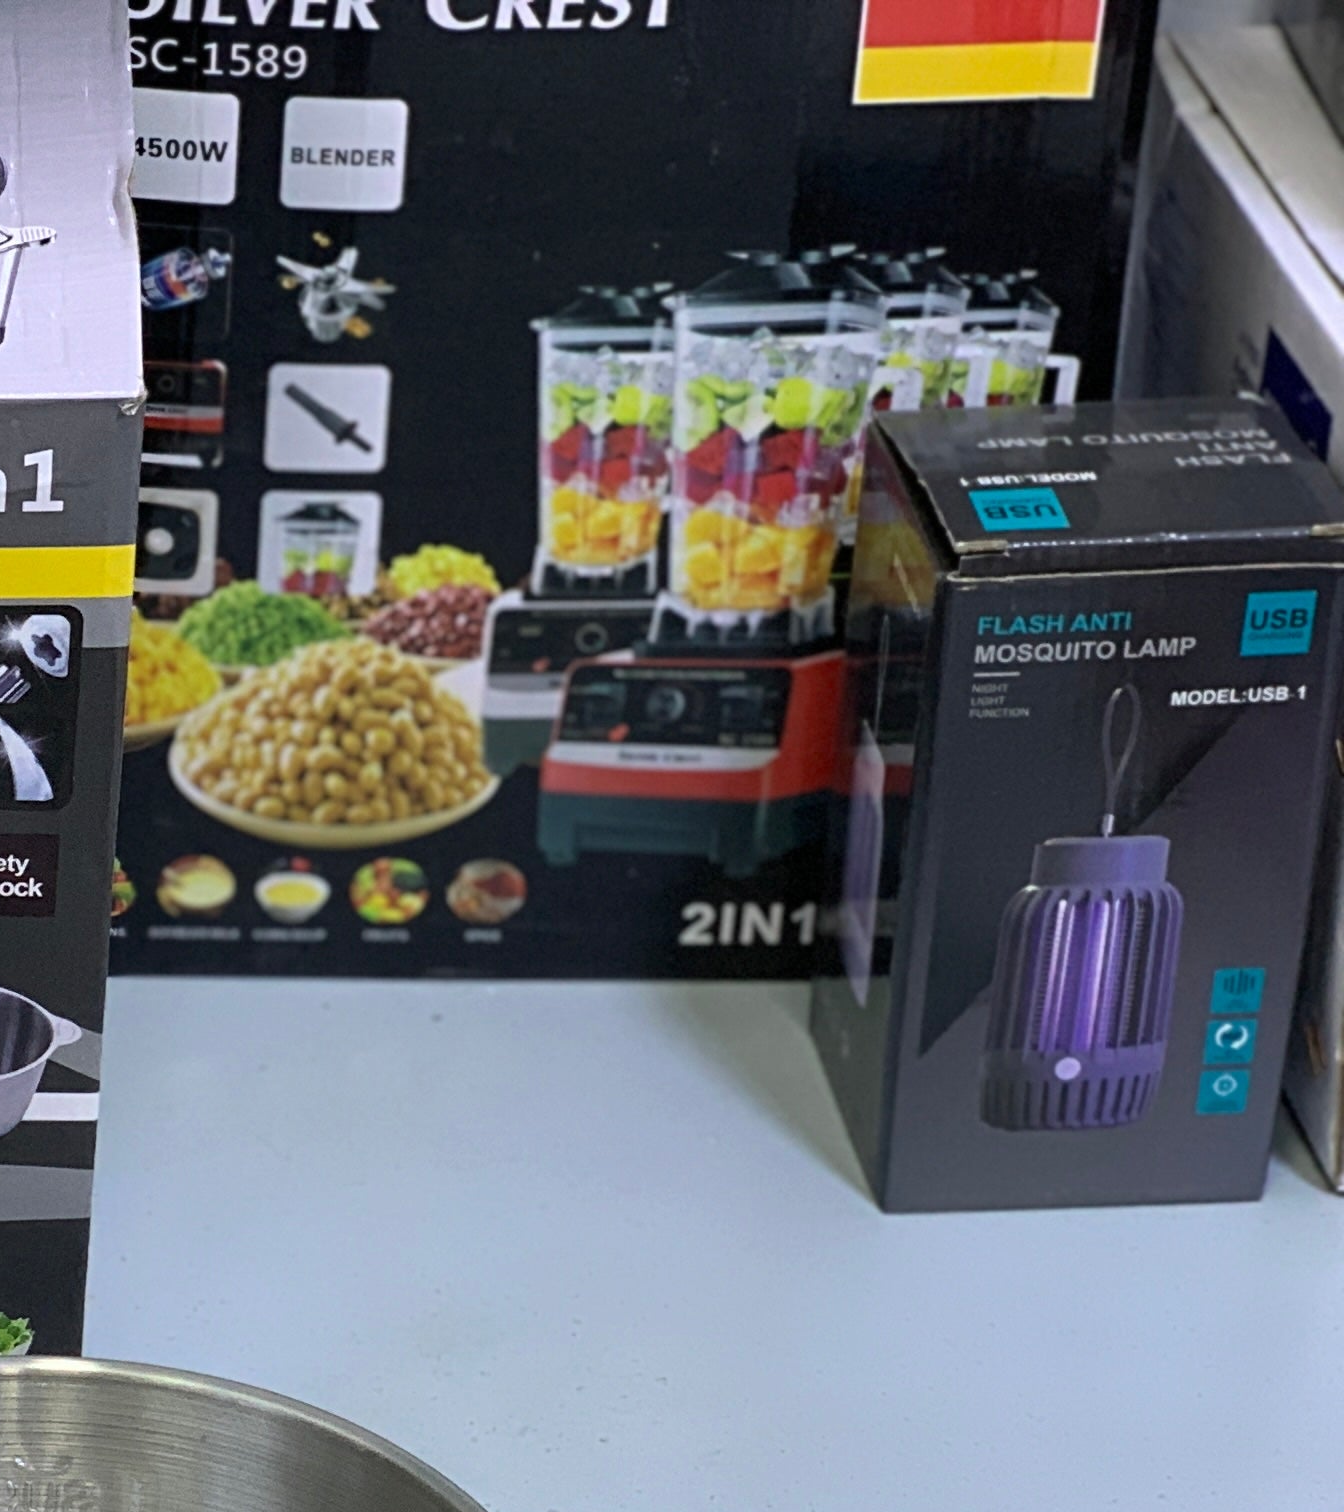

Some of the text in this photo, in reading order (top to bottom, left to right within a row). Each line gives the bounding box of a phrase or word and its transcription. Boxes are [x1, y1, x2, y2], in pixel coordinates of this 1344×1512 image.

[129, 38, 307, 76] SC-1589
[134, 137, 227, 161] 4500W
[290, 147, 395, 165] BLENDER
[977, 429, 1268, 447] MOSQUITO LAMP
[1174, 453, 1291, 465] FLASH
[984, 503, 1057, 518] USB
[977, 611, 1133, 634] FLASH ANTI
[1250, 608, 1307, 629] USB
[974, 636, 1196, 663] MOSQUITO LAMP
[678, 902, 816, 945] 2IN1
